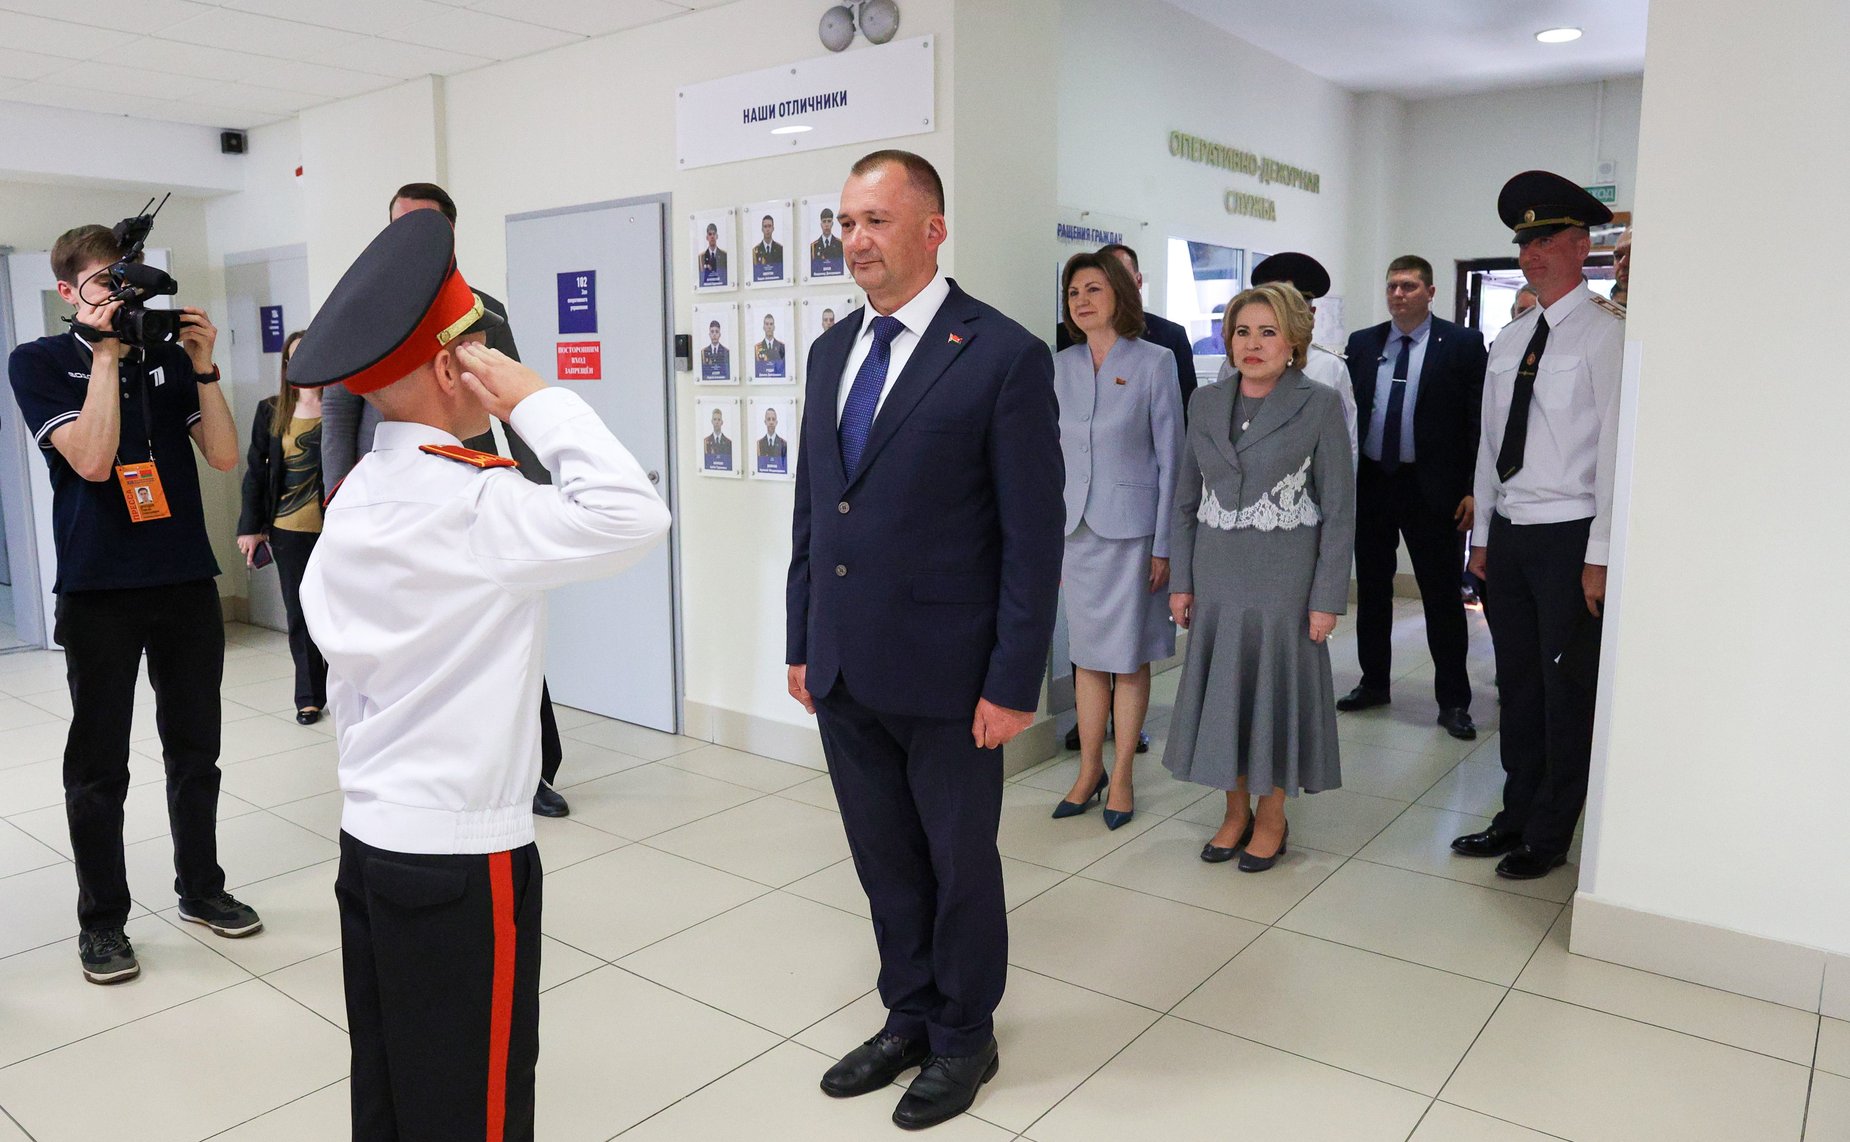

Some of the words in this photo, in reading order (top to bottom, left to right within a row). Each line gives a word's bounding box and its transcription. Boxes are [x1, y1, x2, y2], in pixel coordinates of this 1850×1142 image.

[743, 103, 776, 124] НАШИ
[779, 90, 847, 117] ОТЛИЧНИКИ
[1168, 130, 1321, 194] ОПЕРАТИВНО-ДЕЖУРНАЯ
[1224, 188, 1277, 222] СЛУЖБА
[1091, 228, 1123, 245] ГРАЖДАН
[576, 276, 588, 288] 102
[126, 489, 140, 521] ПРЕССА
